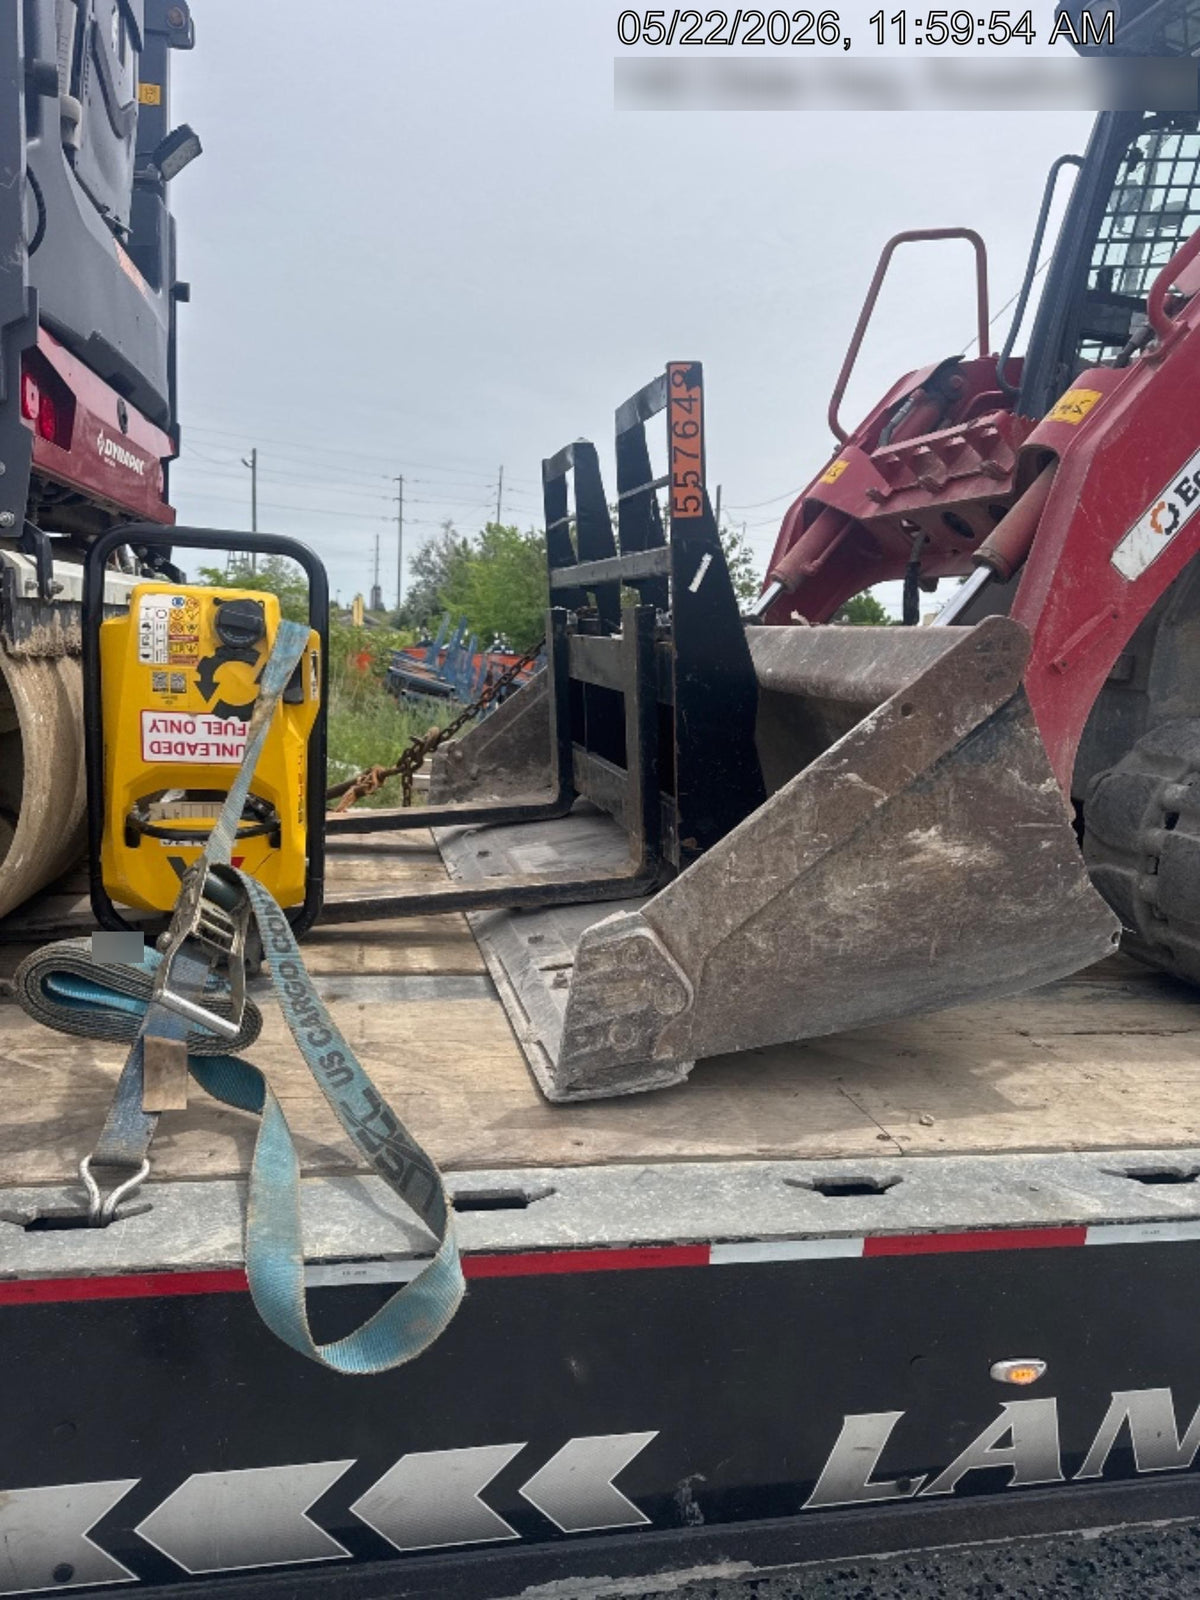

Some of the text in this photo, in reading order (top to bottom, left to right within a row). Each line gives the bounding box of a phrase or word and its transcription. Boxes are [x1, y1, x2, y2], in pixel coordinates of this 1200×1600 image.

[149, 719, 246, 736] FUEL ONLY
[149, 741, 245, 757] UNLEADED
[279, 959, 333, 1047] CARGO
[319, 1050, 354, 1089] US
